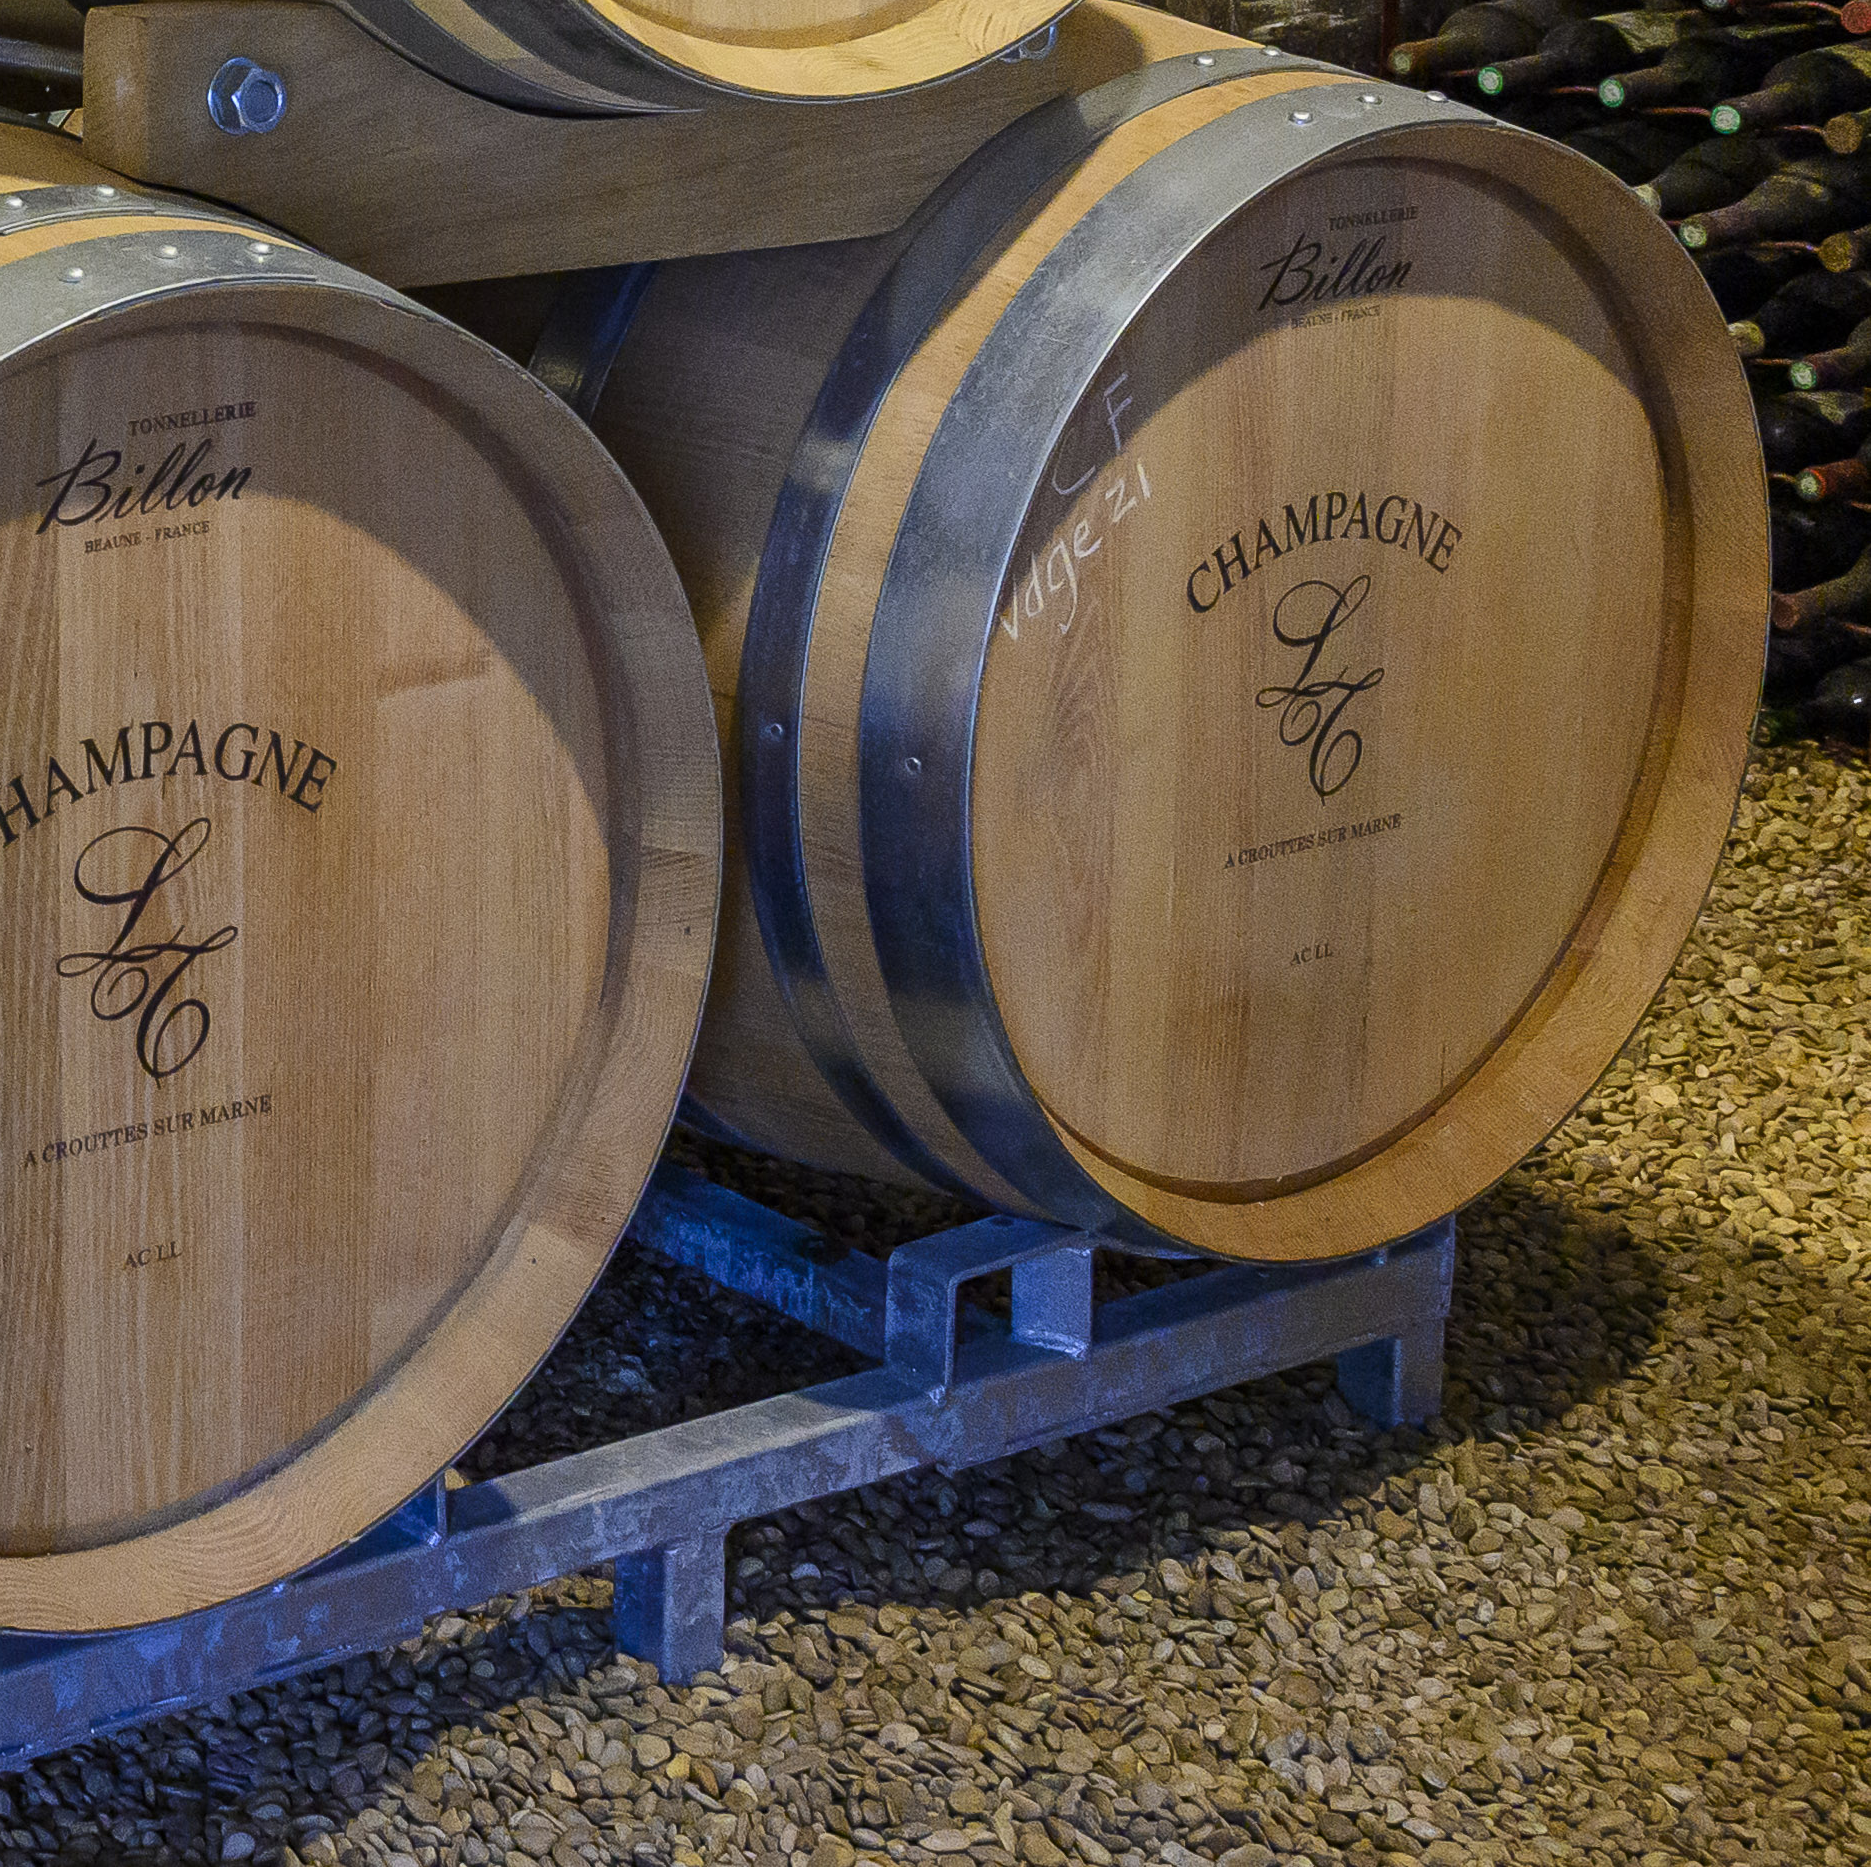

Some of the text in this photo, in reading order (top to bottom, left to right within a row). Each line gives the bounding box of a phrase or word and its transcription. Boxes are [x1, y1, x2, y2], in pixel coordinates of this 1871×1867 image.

[1257, 232, 1413, 311] Billon
[129, 401, 256, 436] TONNELLERIE
[35, 438, 252, 535] Billon
[85, 532, 142, 553] BEAUNE
[155, 521, 210, 542] FRANCE
[1186, 490, 1462, 614] CHAMPAGNE
[1224, 813, 1401, 869] A CROUTTES SUR MARNE
[23, 1094, 272, 1168] A CROUTTES SUR MARNE
